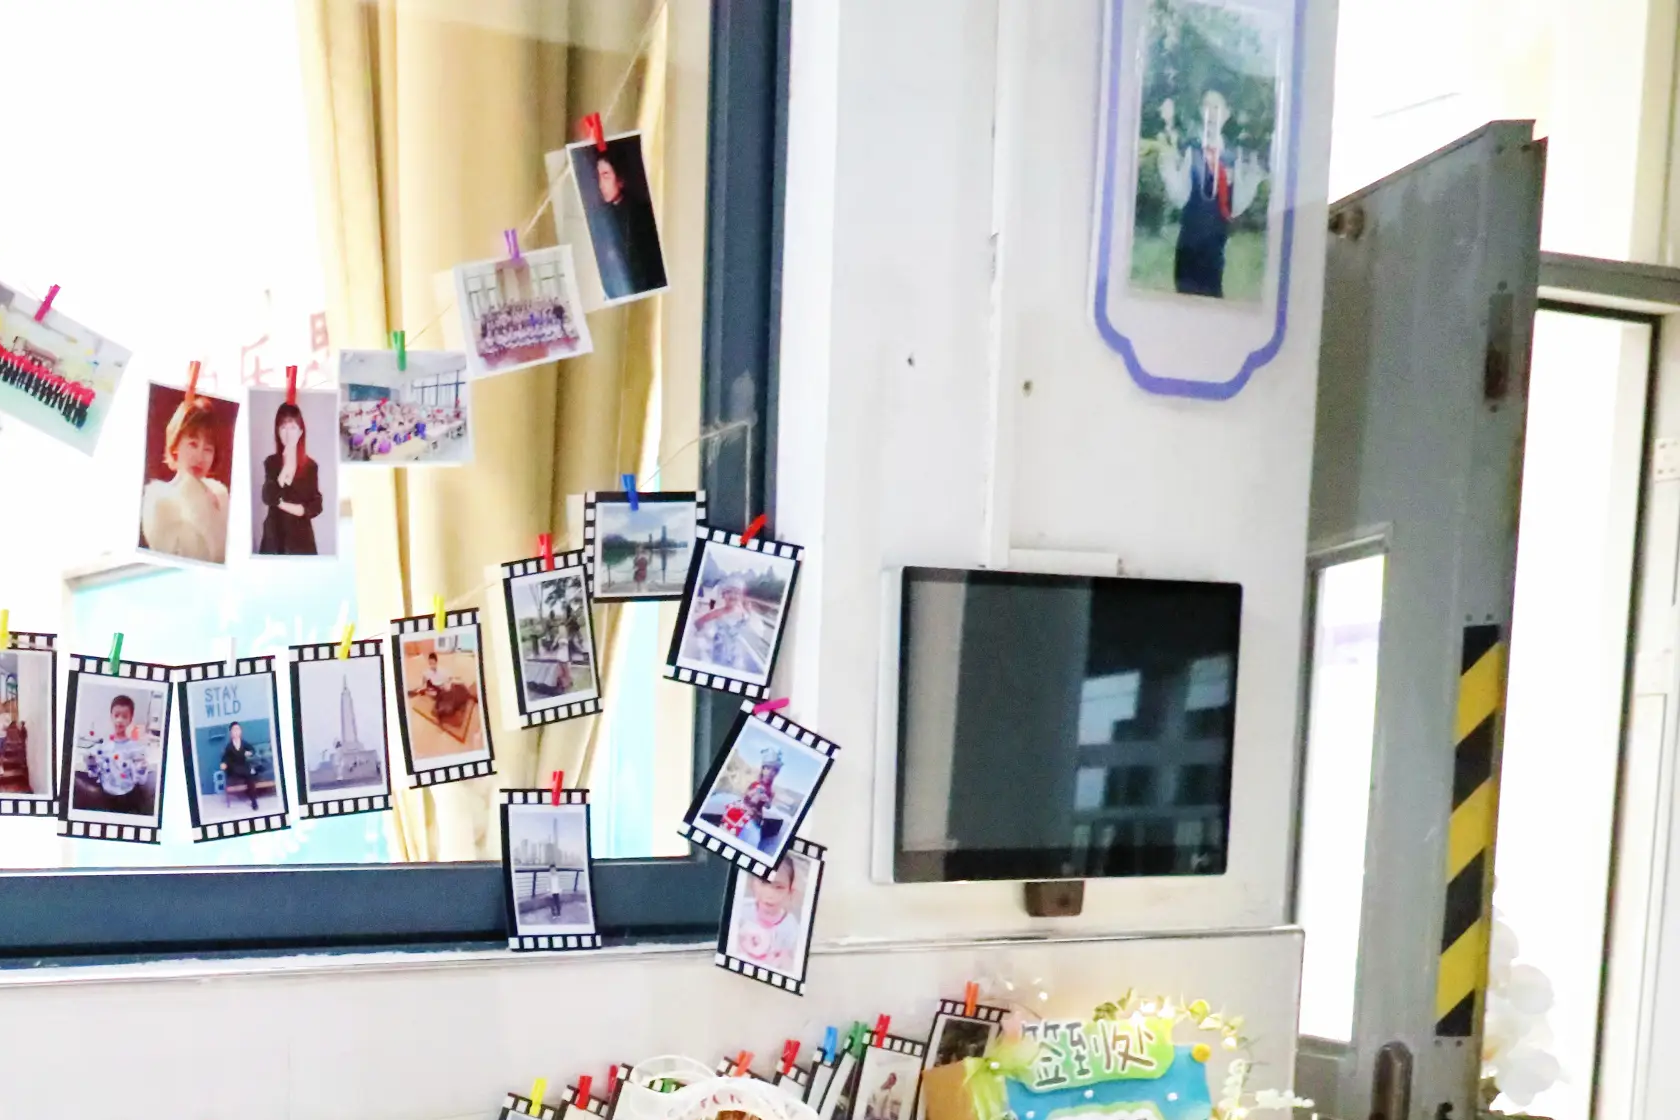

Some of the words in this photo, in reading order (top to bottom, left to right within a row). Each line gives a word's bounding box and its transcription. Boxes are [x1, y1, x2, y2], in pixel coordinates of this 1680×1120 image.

[205, 685, 238, 702] STAY
[206, 700, 240, 718] WILD
[1021, 1022, 1155, 1087] 签到处
